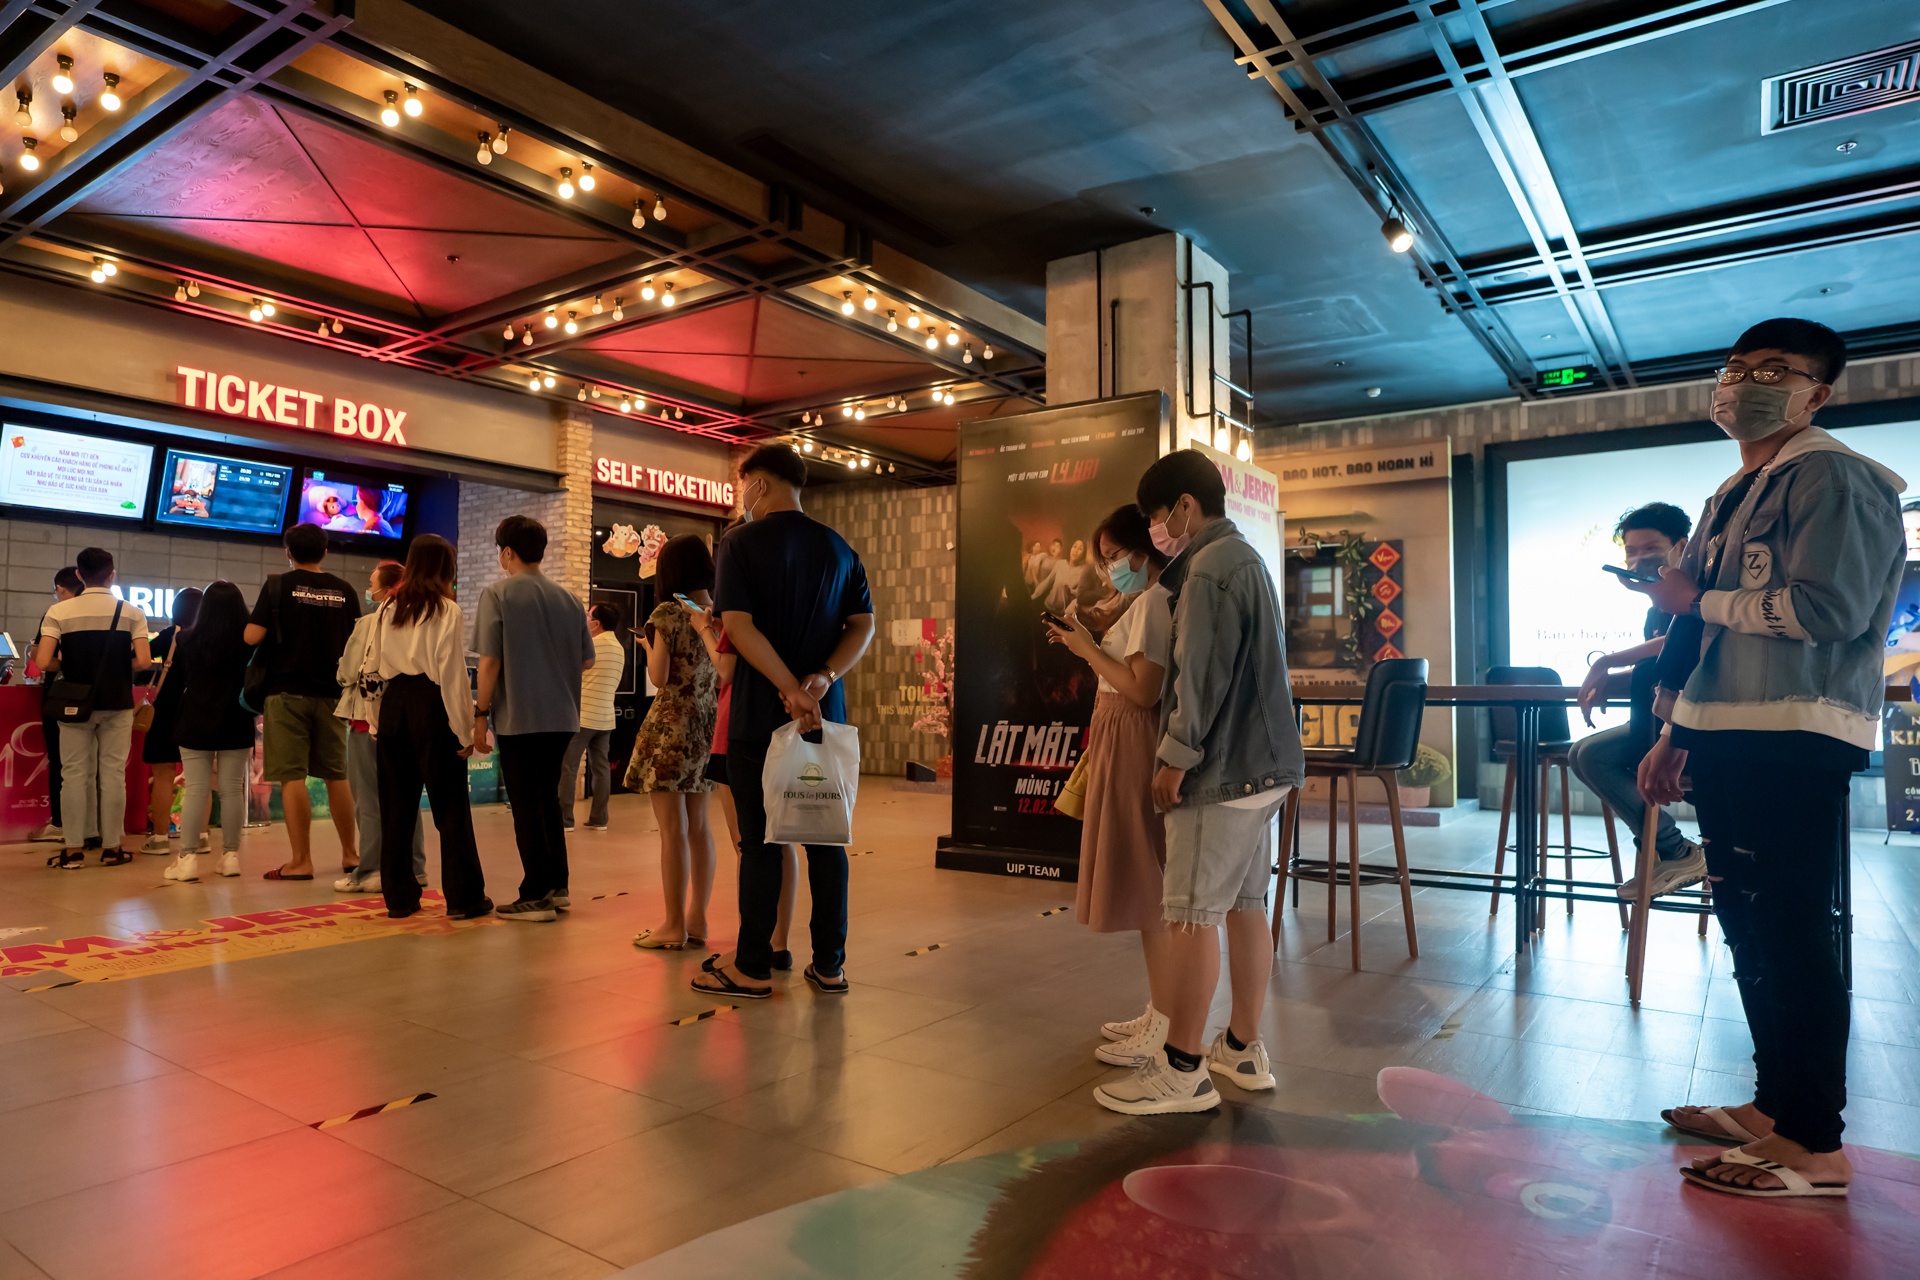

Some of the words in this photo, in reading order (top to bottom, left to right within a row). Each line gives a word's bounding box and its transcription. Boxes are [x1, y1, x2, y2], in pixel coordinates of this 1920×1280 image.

[177, 366, 323, 429] TICKET
[334, 398, 407, 445] BOX
[596, 458, 642, 488] SELF
[646, 468, 734, 505] TICKETING
[1283, 468, 1308, 481] BAO
[1346, 462, 1372, 475] BAO
[1378, 458, 1414, 472] HOAN
[1242, 472, 1276, 508] JERRY
[1228, 498, 1243, 514] TUNG
[1244, 504, 1256, 518] NEW
[1258, 508, 1272, 524] YORK
[876, 705, 894, 715] THIS
[896, 705, 914, 716] WAY
[974, 720, 1024, 767] LẬT
[815, 792, 842, 800] JOURS
[1053, 780, 1060, 796] 1
[1007, 863, 1025, 874] UIP
[1028, 865, 1060, 878] TEAM
[87, 937, 230, 960] TUNG
[240, 919, 338, 938] NEW
